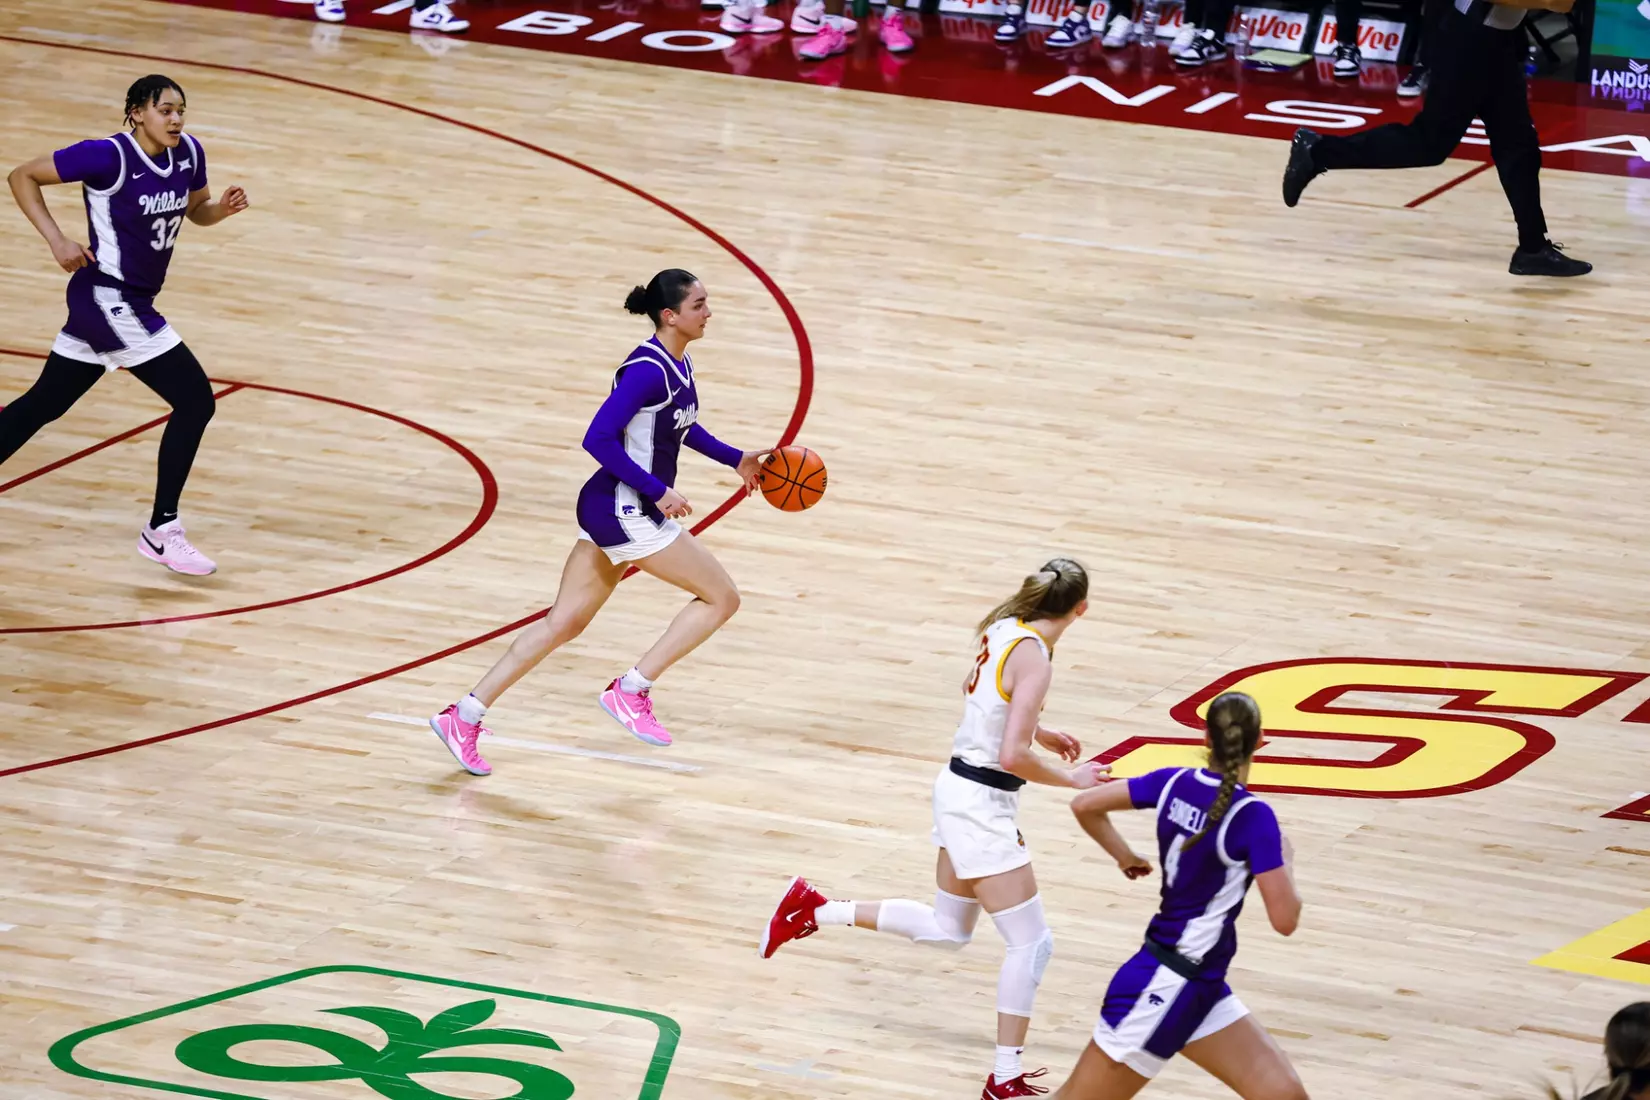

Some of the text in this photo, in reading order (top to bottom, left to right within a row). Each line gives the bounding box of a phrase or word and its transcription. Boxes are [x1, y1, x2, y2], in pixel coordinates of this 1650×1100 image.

[1321, 22, 1399, 51] HVee
[1591, 68, 1650, 90] LANDU
[150, 215, 181, 251] 32
